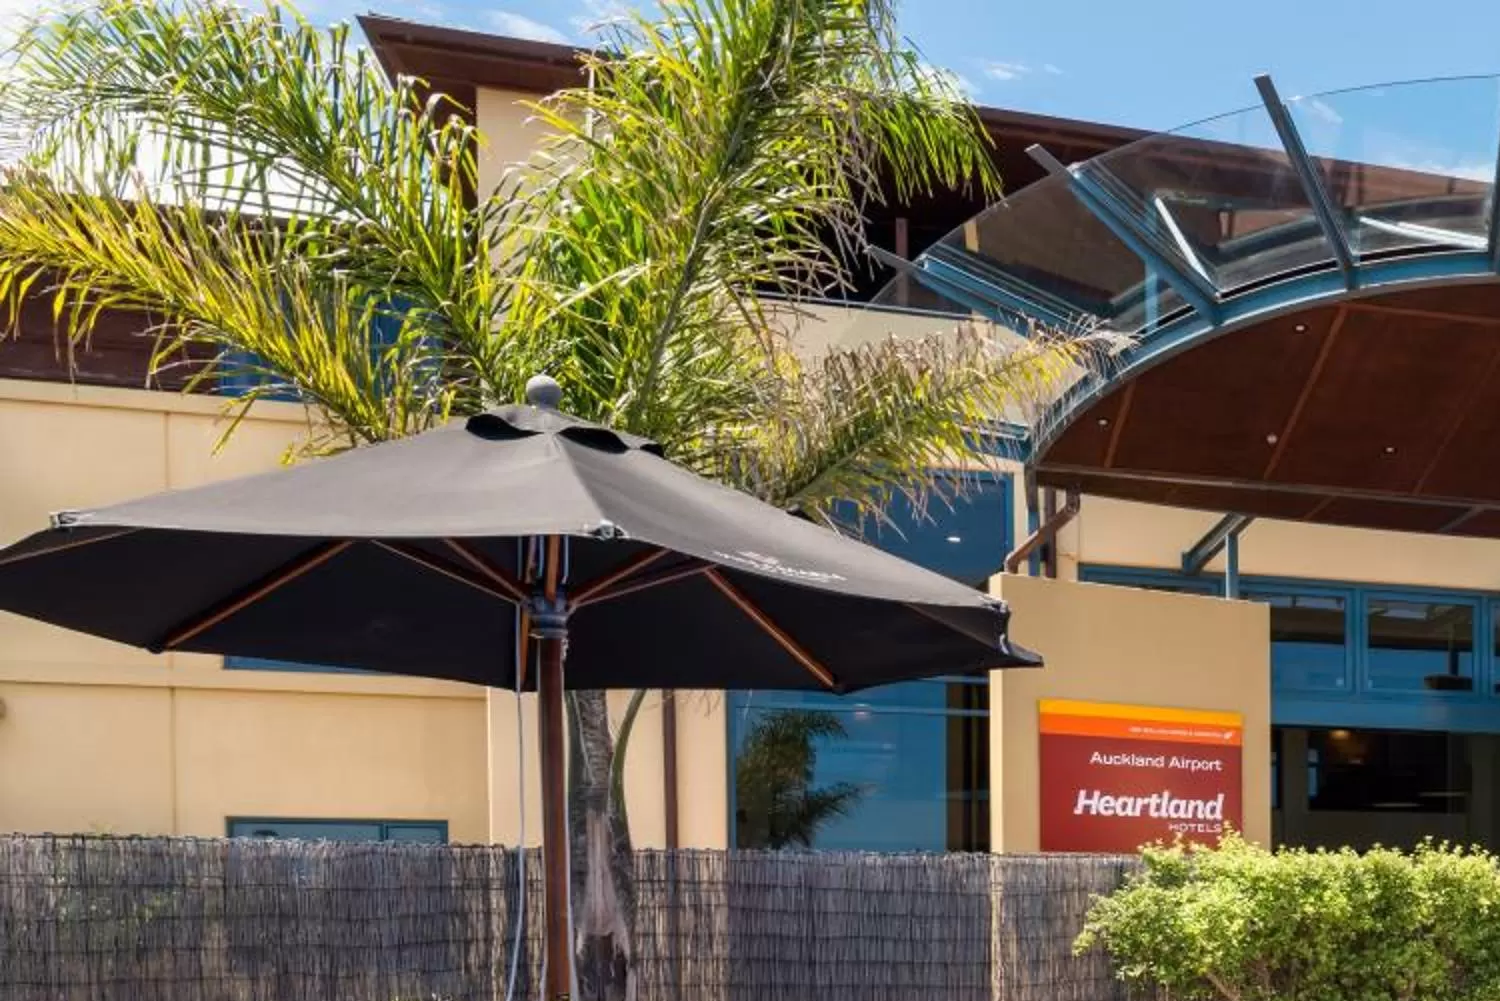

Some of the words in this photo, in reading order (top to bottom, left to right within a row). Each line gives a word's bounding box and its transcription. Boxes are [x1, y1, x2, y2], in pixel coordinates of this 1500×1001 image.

[1090, 751, 1165, 769] Auckland
[1168, 756, 1222, 772] Airport
[1074, 789, 1225, 820] Heartland
[1168, 823, 1222, 833] HOTELS
